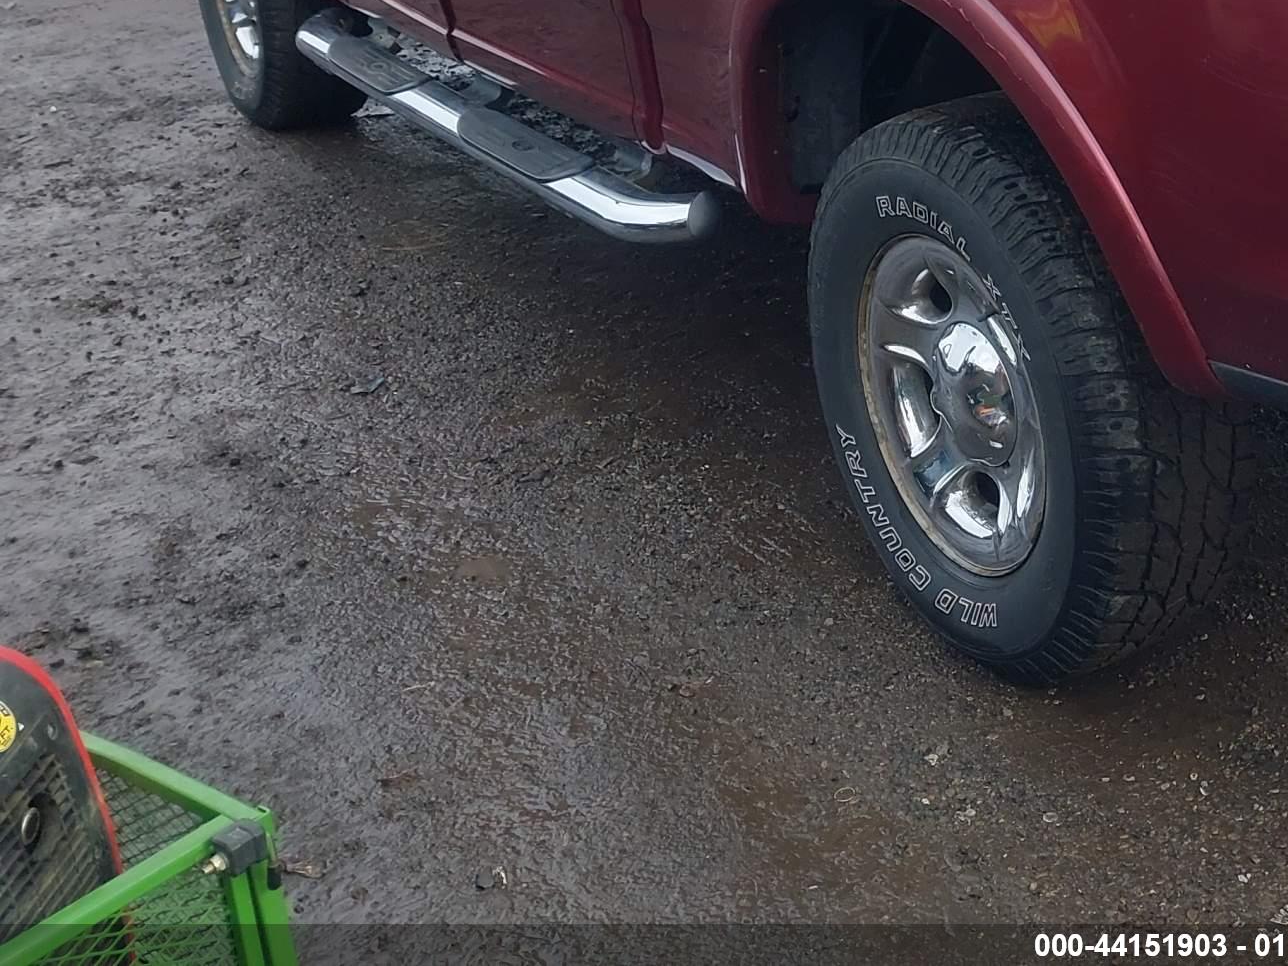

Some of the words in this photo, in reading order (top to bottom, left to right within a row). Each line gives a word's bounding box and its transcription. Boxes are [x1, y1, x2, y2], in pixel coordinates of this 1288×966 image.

[875, 195, 972, 262] RADIAL
[835, 423, 932, 592] COUNTRY
[934, 587, 998, 628] WILD
